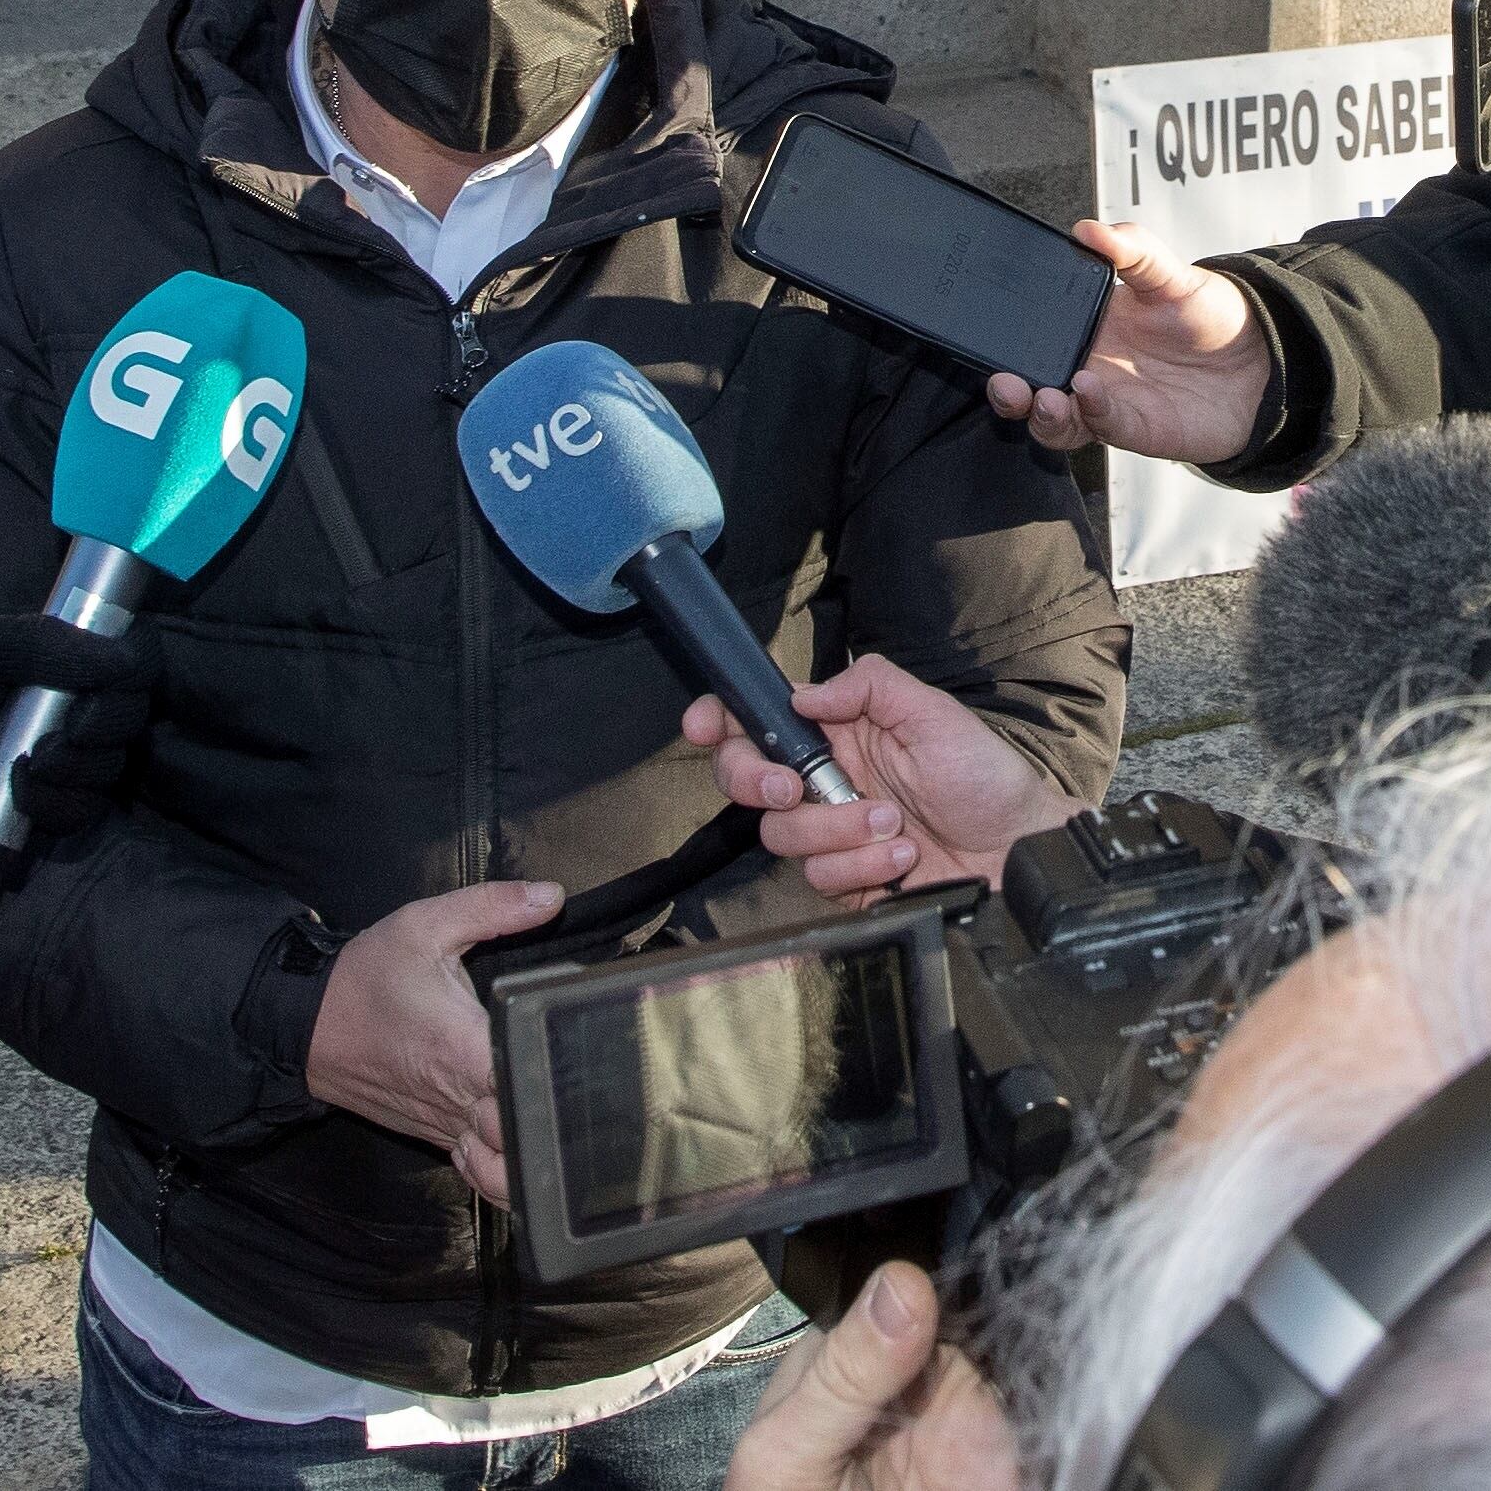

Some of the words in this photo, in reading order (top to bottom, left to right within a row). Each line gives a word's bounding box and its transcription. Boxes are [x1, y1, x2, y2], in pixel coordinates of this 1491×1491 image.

[1155, 89, 1319, 187] QUIERO
[89, 331, 193, 440] G
[221, 377, 294, 493] G
[488, 402, 603, 492] tve
